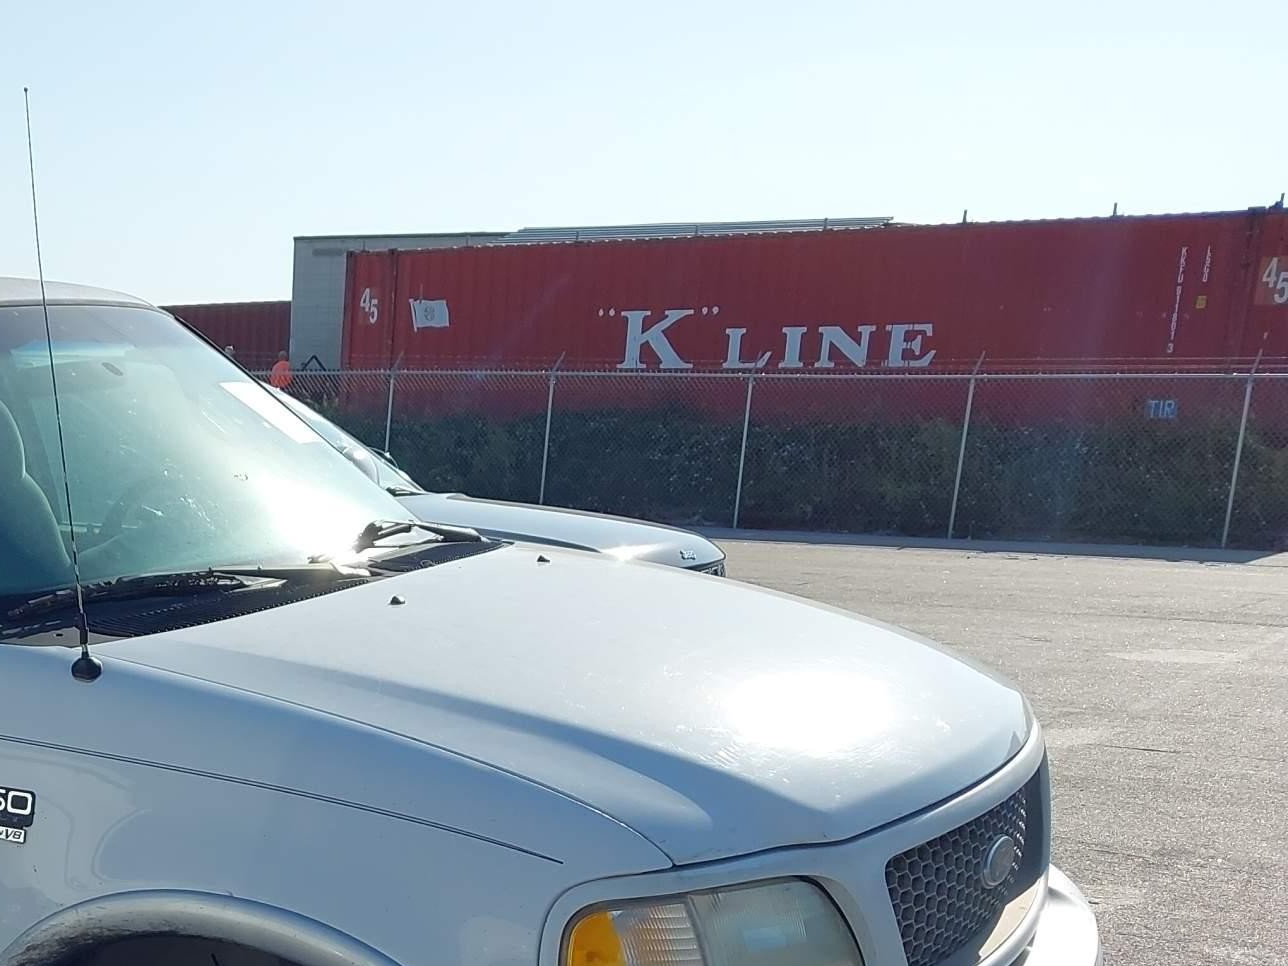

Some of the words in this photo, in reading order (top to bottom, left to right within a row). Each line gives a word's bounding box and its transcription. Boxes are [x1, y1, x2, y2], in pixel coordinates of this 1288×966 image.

[359, 287, 379, 324] 45
[721, 323, 937, 369] LINE
[1147, 399, 1176, 418] TIR
[4, 828, 23, 840] V8
